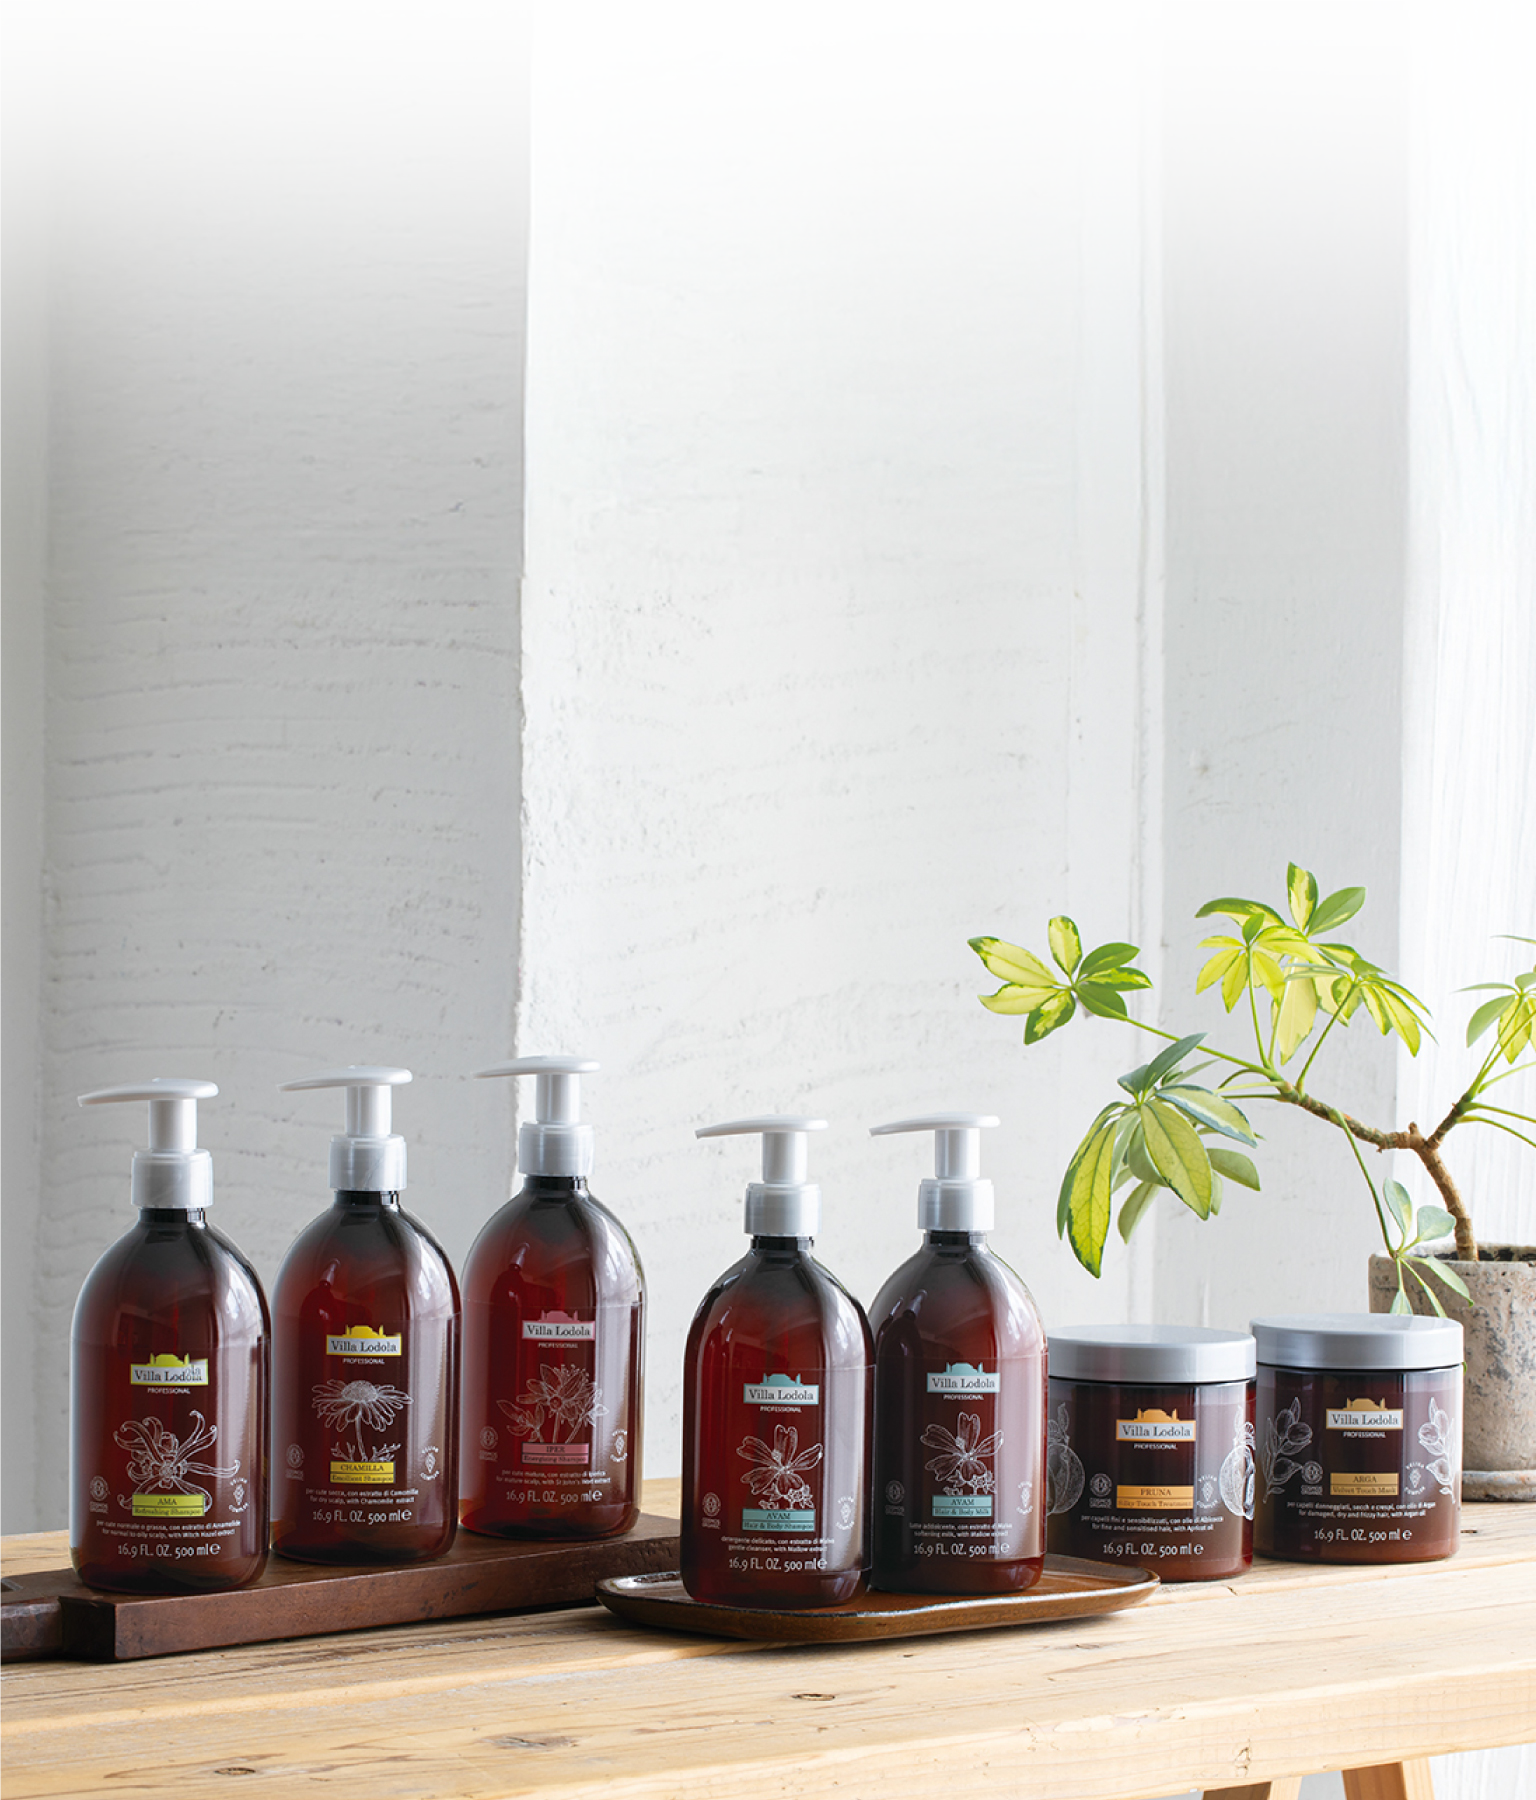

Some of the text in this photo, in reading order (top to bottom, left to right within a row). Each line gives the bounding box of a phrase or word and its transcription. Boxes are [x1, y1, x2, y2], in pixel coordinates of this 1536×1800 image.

[527, 1325, 590, 1336] Villa Lodola
[331, 1341, 397, 1352] Villa Lodola
[134, 1370, 161, 1381] Villa
[932, 1378, 995, 1388] Villa Lodola
[749, 1389, 813, 1400] Villa Lodola
[1331, 1414, 1398, 1425] Villa Lodola
[1122, 1425, 1191, 1437] Villa Lodola
[506, 1490, 525, 1504] 16.9
[528, 1491, 540, 1502] FL.
[543, 1491, 558, 1502] OZ.
[561, 1494, 578, 1505] 500
[313, 1509, 331, 1523] 16.9
[334, 1510, 347, 1522] FL.
[350, 1510, 365, 1522] OZ.
[368, 1513, 386, 1525] 500
[959, 1508, 973, 1516] Body
[767, 1522, 783, 1530] Body
[1314, 1528, 1333, 1542] 16.9
[1336, 1529, 1348, 1540] FL.
[1351, 1529, 1367, 1540] OZ.
[1369, 1532, 1386, 1543] 500
[118, 1543, 137, 1558] 16.9
[140, 1544, 153, 1555] FL.
[156, 1545, 172, 1556] OZ.
[175, 1548, 194, 1559] 500
[914, 1543, 934, 1557] 16.9
[936, 1544, 948, 1554] FL.
[951, 1544, 966, 1554] OZ.
[970, 1545, 987, 1557] 500
[1103, 1542, 1123, 1557] 16.9
[1125, 1543, 1138, 1554] FL.
[1141, 1544, 1156, 1555] OZ.
[1159, 1546, 1177, 1558] 500
[729, 1557, 748, 1571] 16.9
[750, 1558, 763, 1569] FL.
[766, 1558, 781, 1569] OZ.
[784, 1561, 802, 1572] 500
